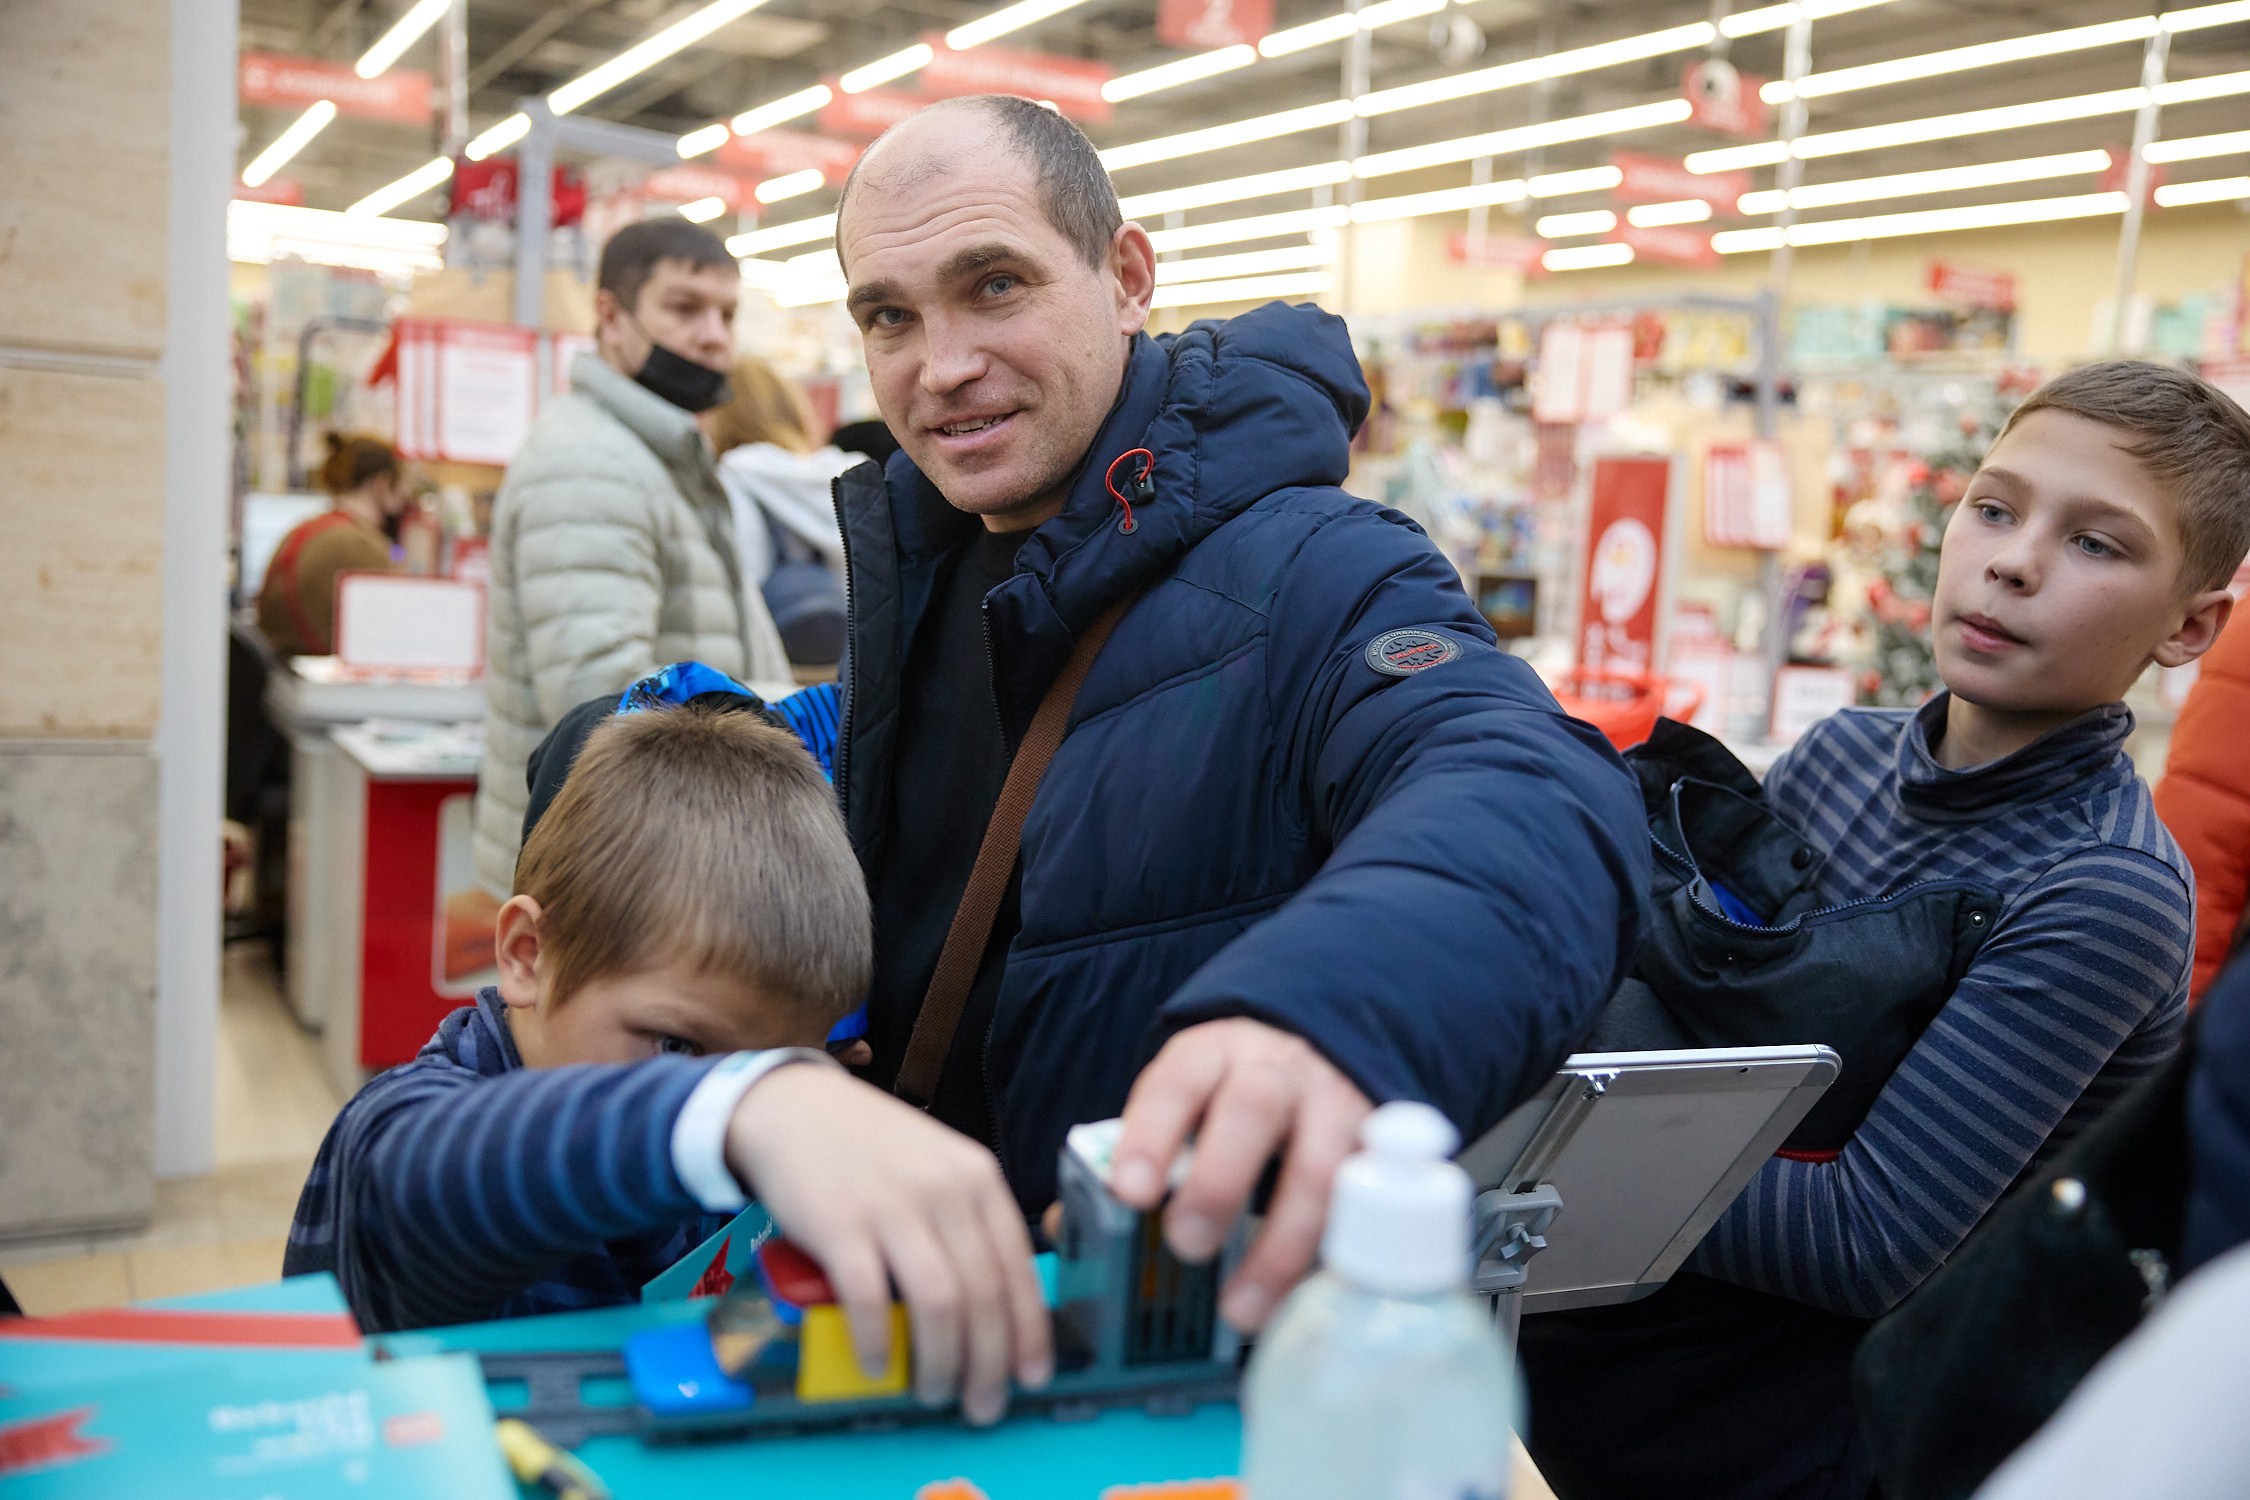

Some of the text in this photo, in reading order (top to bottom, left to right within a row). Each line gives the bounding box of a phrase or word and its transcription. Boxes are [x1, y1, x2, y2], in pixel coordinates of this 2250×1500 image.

[1371, 635, 1390, 656] MODERN
[1421, 631, 1440, 639] MEN
[1388, 643, 1439, 660] TALIPECK
[1379, 663, 1414, 672] PRODUCT
